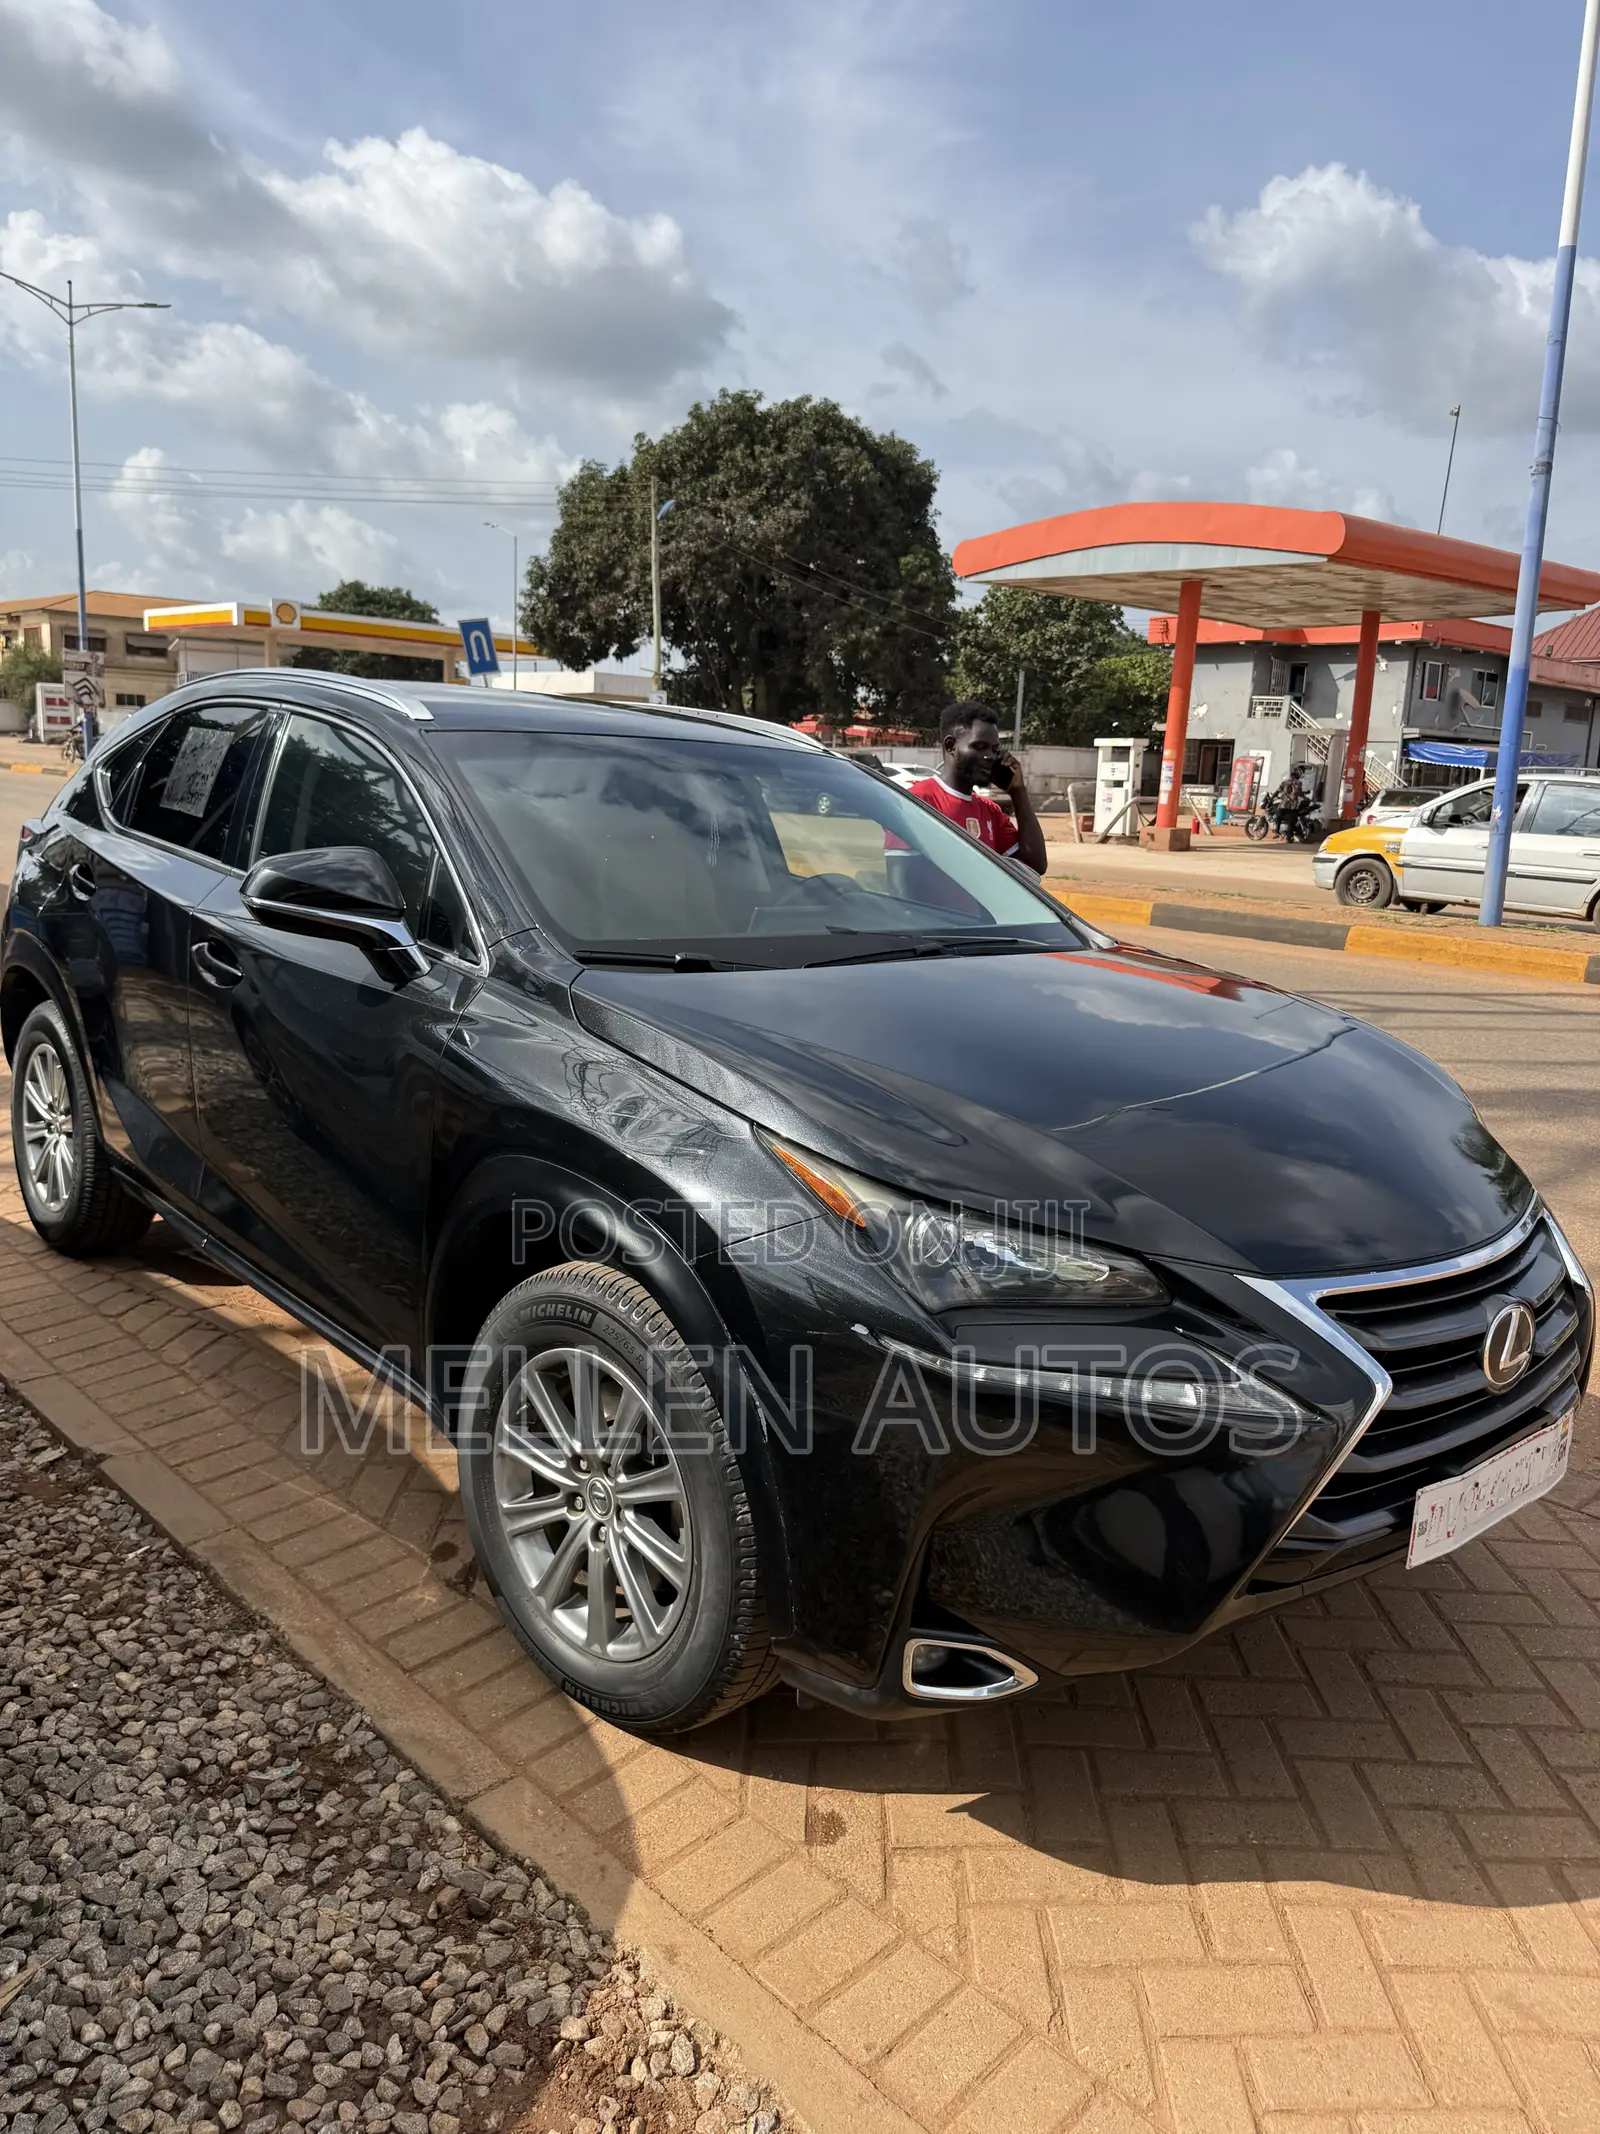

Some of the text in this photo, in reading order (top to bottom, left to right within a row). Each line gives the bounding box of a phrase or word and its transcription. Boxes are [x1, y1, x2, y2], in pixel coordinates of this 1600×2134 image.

[520, 1303, 592, 1325] MICHELIN
[602, 1324, 636, 1355] 225/65
[563, 1681, 641, 1715] MICHELIN
